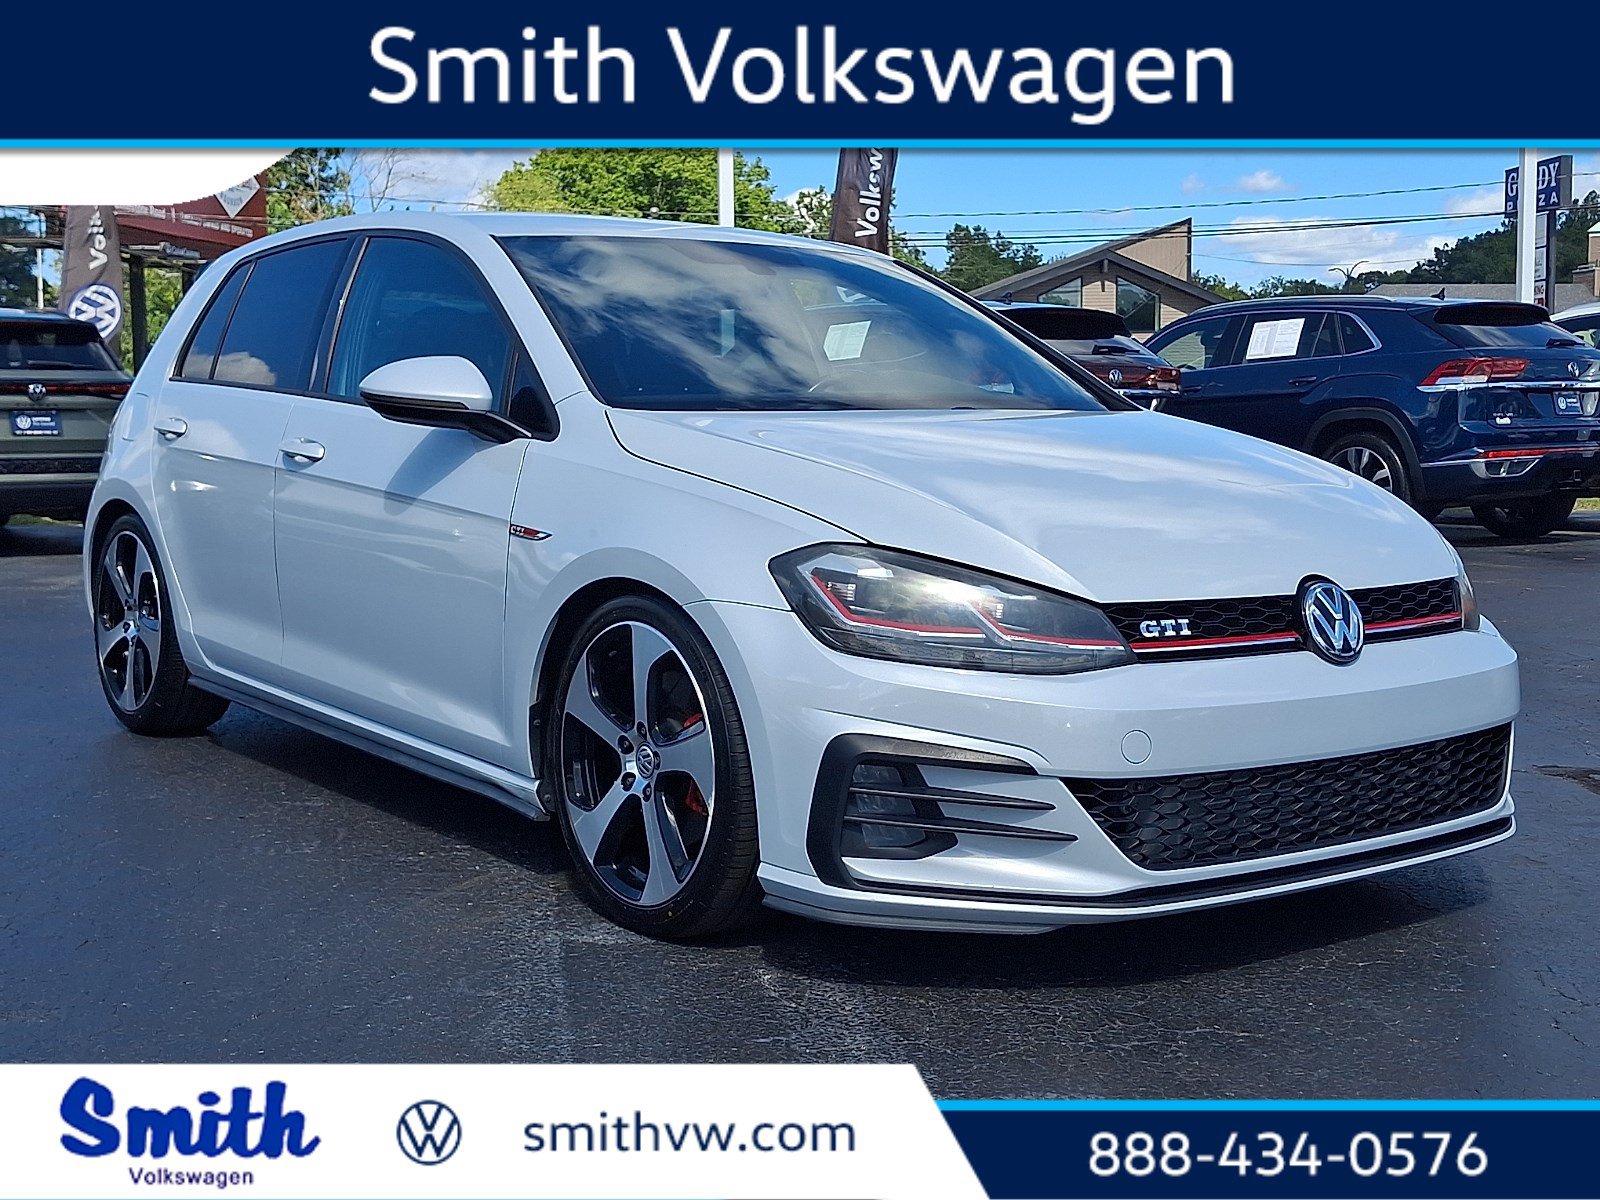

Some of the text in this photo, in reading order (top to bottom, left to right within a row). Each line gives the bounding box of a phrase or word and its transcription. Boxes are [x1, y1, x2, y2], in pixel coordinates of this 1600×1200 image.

[1507, 161, 1560, 197] GDY
[1507, 192, 1559, 212] PZA
[1139, 618, 1192, 638] GTI
